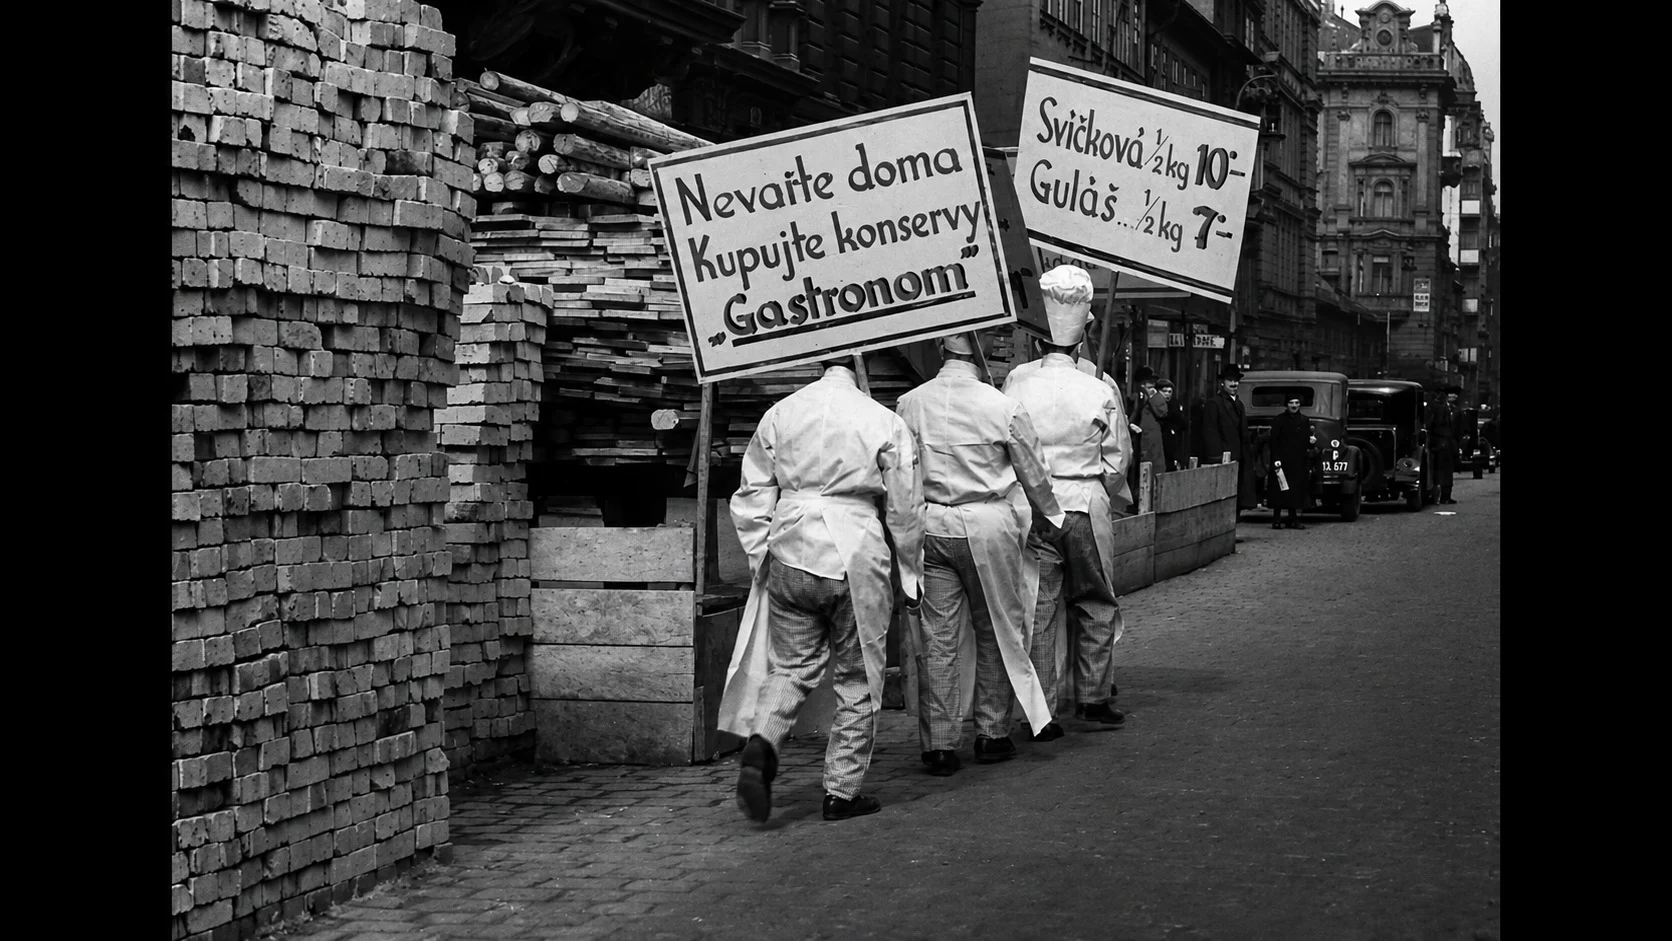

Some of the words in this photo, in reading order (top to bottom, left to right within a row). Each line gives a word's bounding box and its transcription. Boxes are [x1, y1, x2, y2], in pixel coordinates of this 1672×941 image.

[675, 155, 834, 226] Nevařte
[848, 143, 963, 192] doma
[688, 221, 825, 291] Kupujte
[831, 201, 980, 254] konservy
